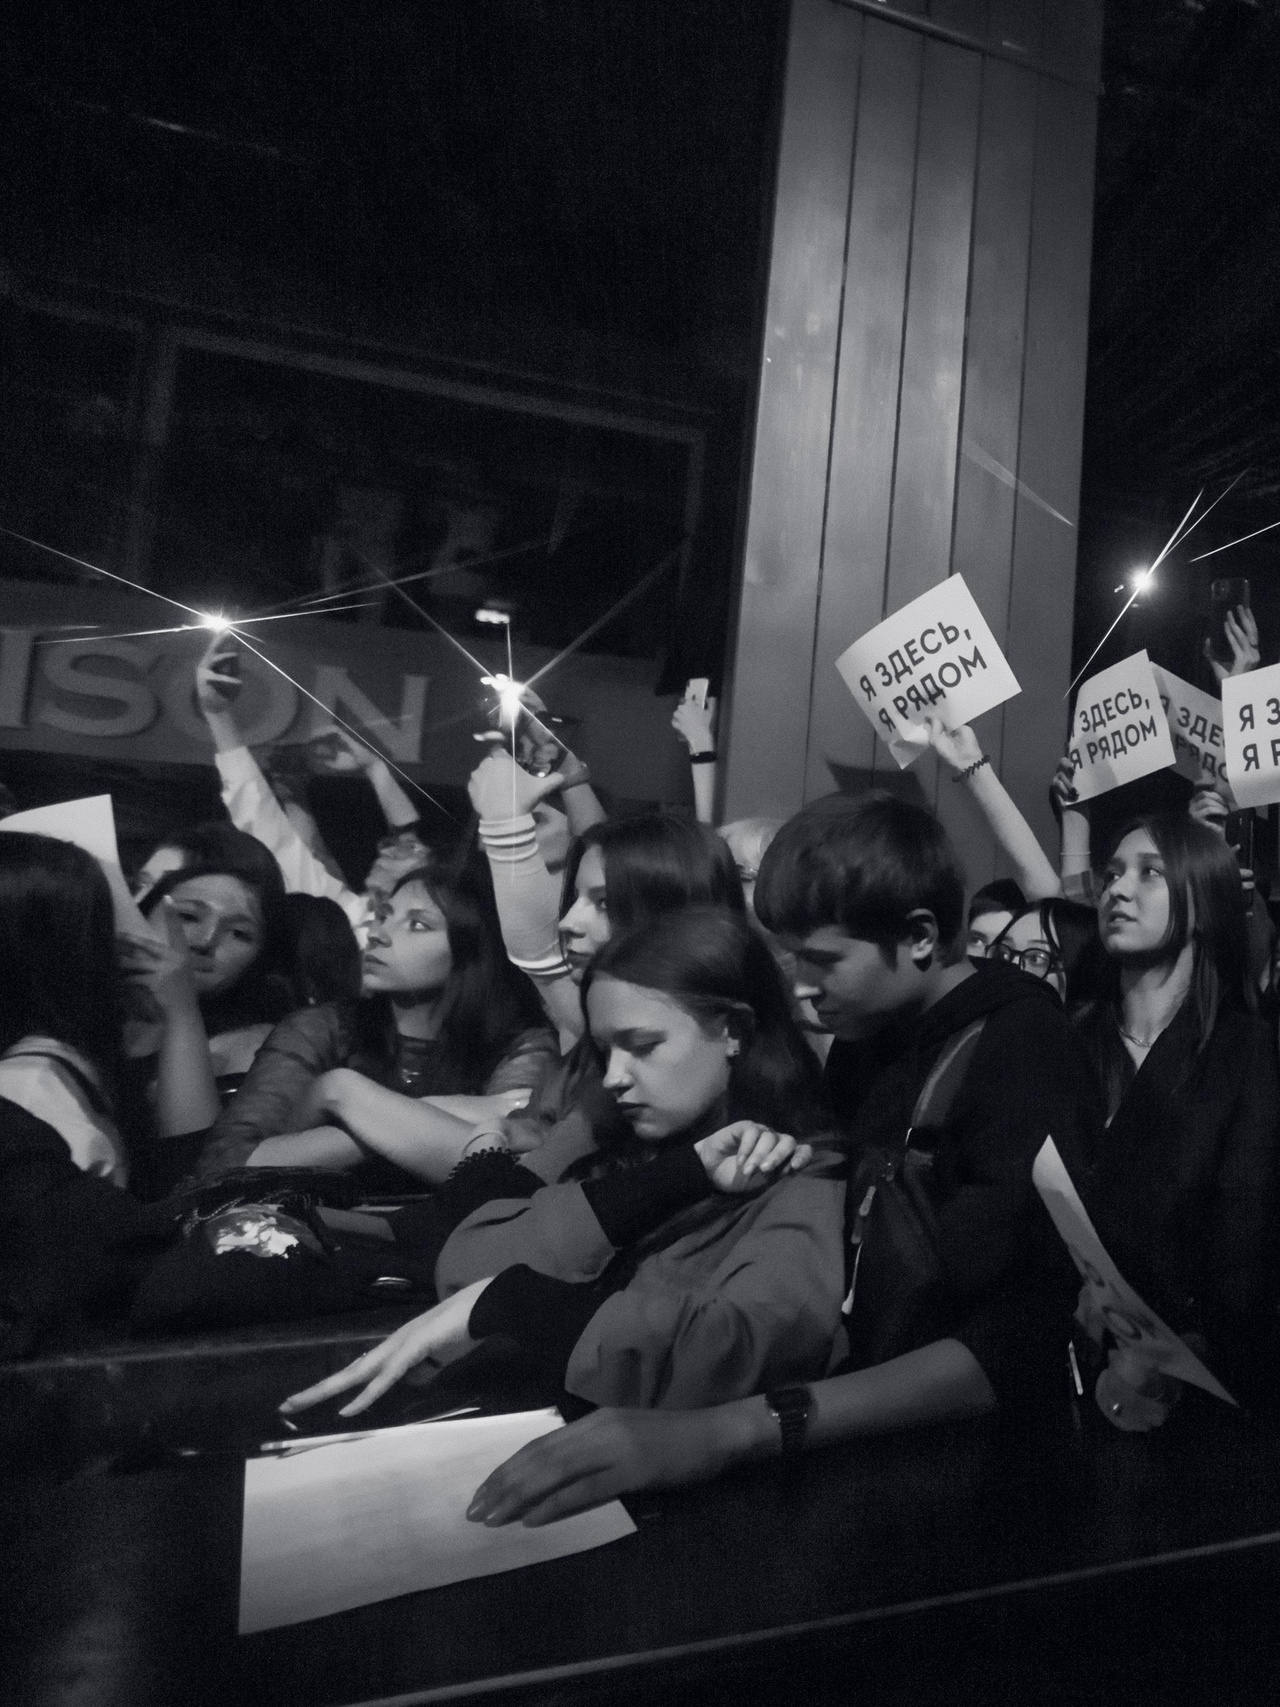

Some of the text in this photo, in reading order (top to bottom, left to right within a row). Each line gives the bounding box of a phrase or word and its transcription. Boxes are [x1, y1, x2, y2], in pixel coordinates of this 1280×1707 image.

[859, 621, 972, 702] Я ЗДЕСЬ,
[878, 645, 988, 733] Я РЯДОМ
[1079, 688, 1150, 733] ЗДЕСЬ,
[1177, 706, 1225, 749] ЗДЕ
[1239, 703, 1255, 732] Я
[1069, 748, 1083, 770] Я
[1086, 715, 1158, 764] РЯДОМ
[1242, 743, 1260, 772] Я
